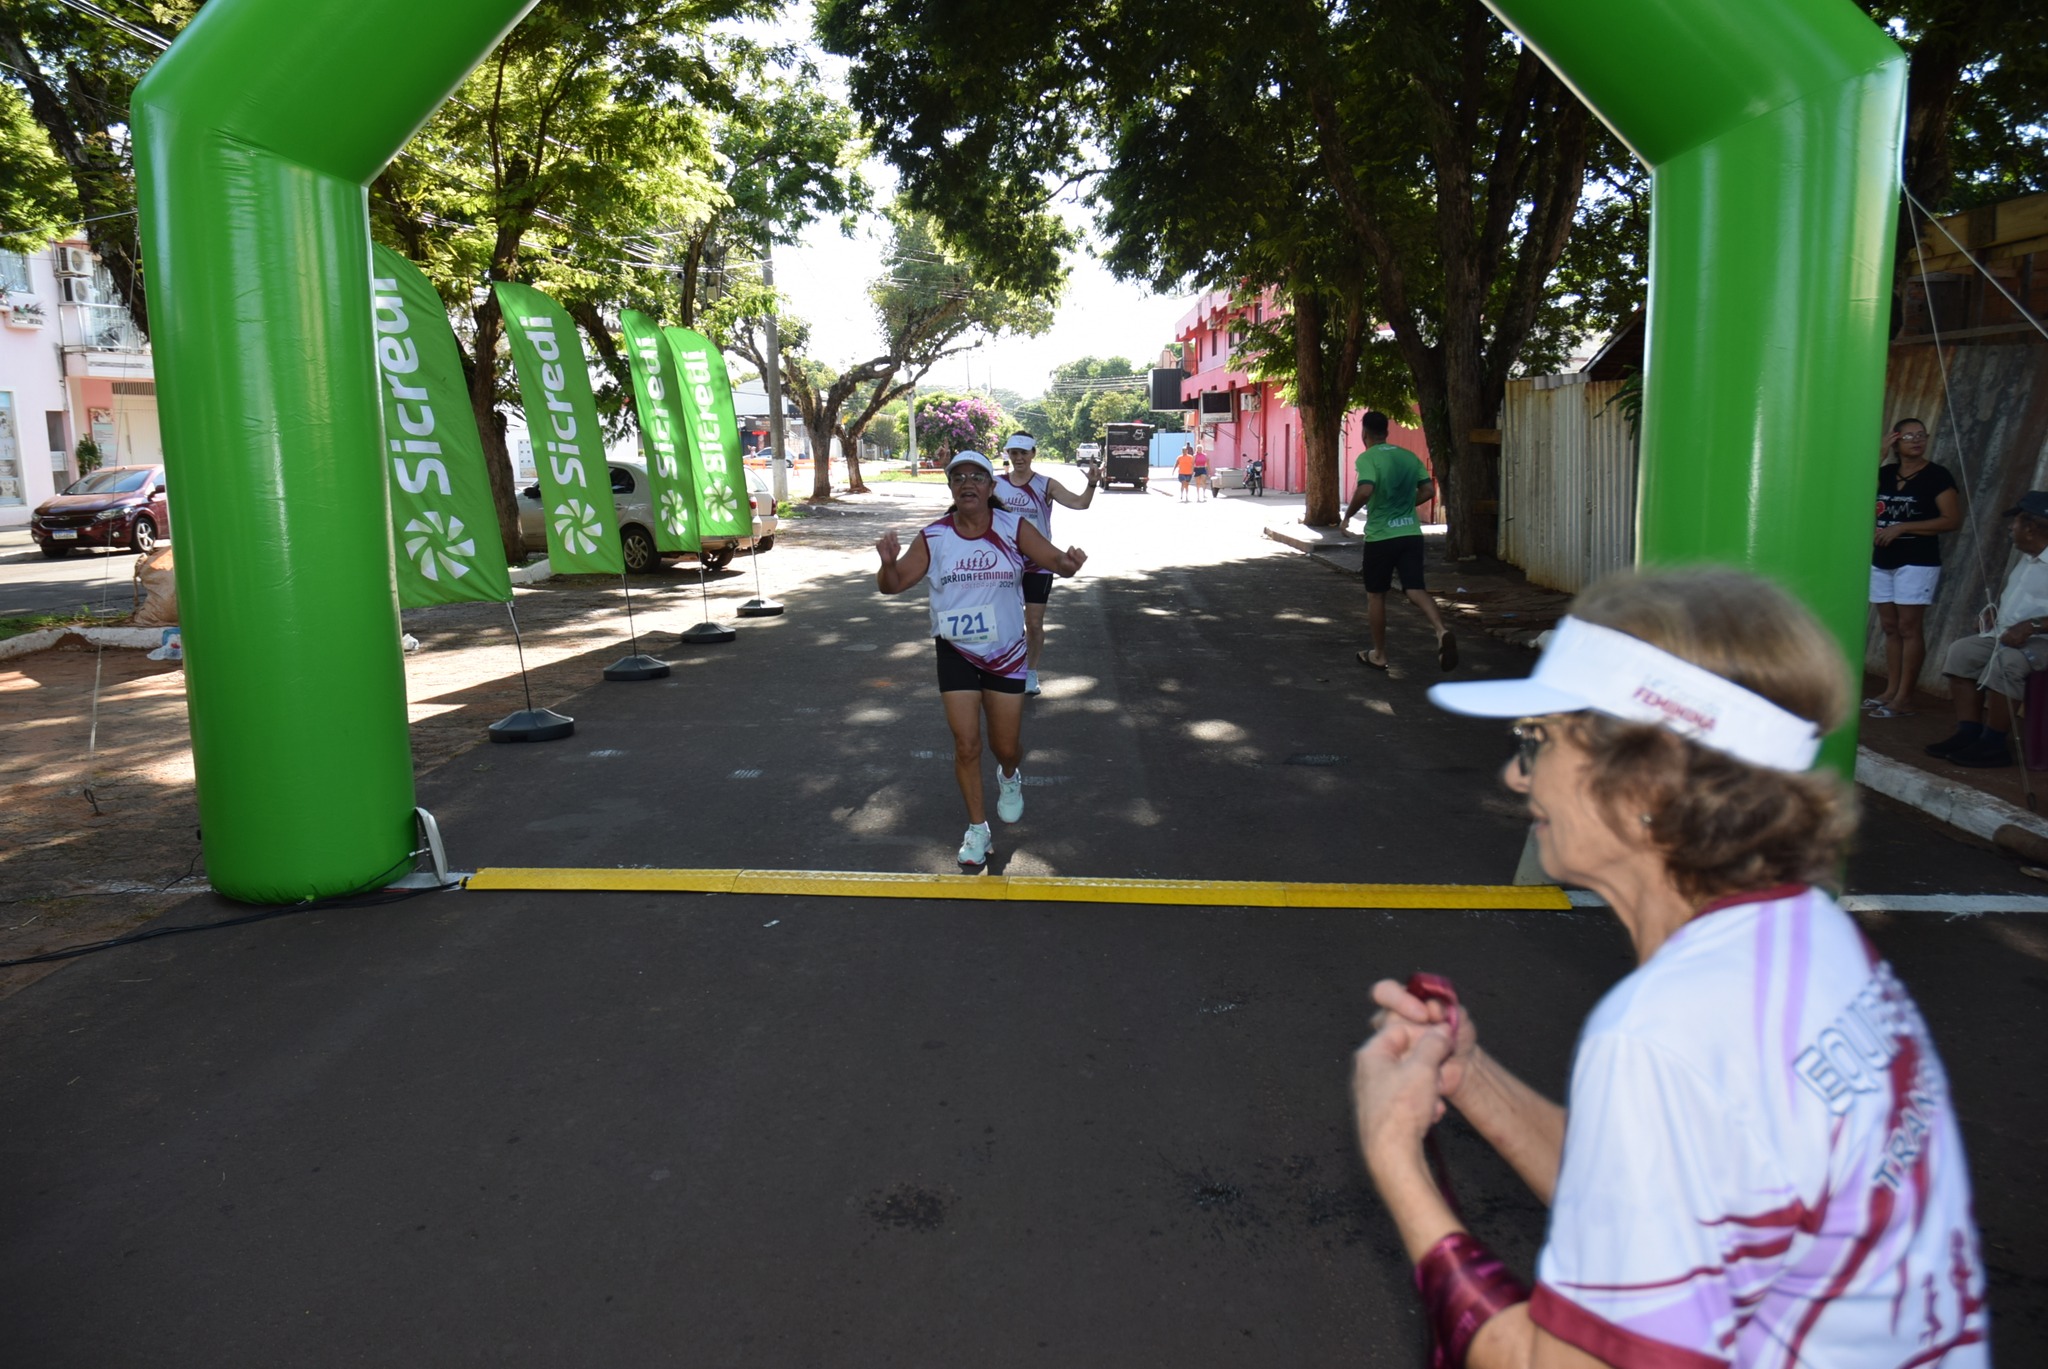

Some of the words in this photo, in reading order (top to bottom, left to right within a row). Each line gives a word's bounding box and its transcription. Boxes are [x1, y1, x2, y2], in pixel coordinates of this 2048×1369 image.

[519, 316, 587, 488] Sicredi
[635, 335, 678, 481] Sicredi
[681, 348, 728, 475] Sicredi
[947, 611, 989, 637] 721
